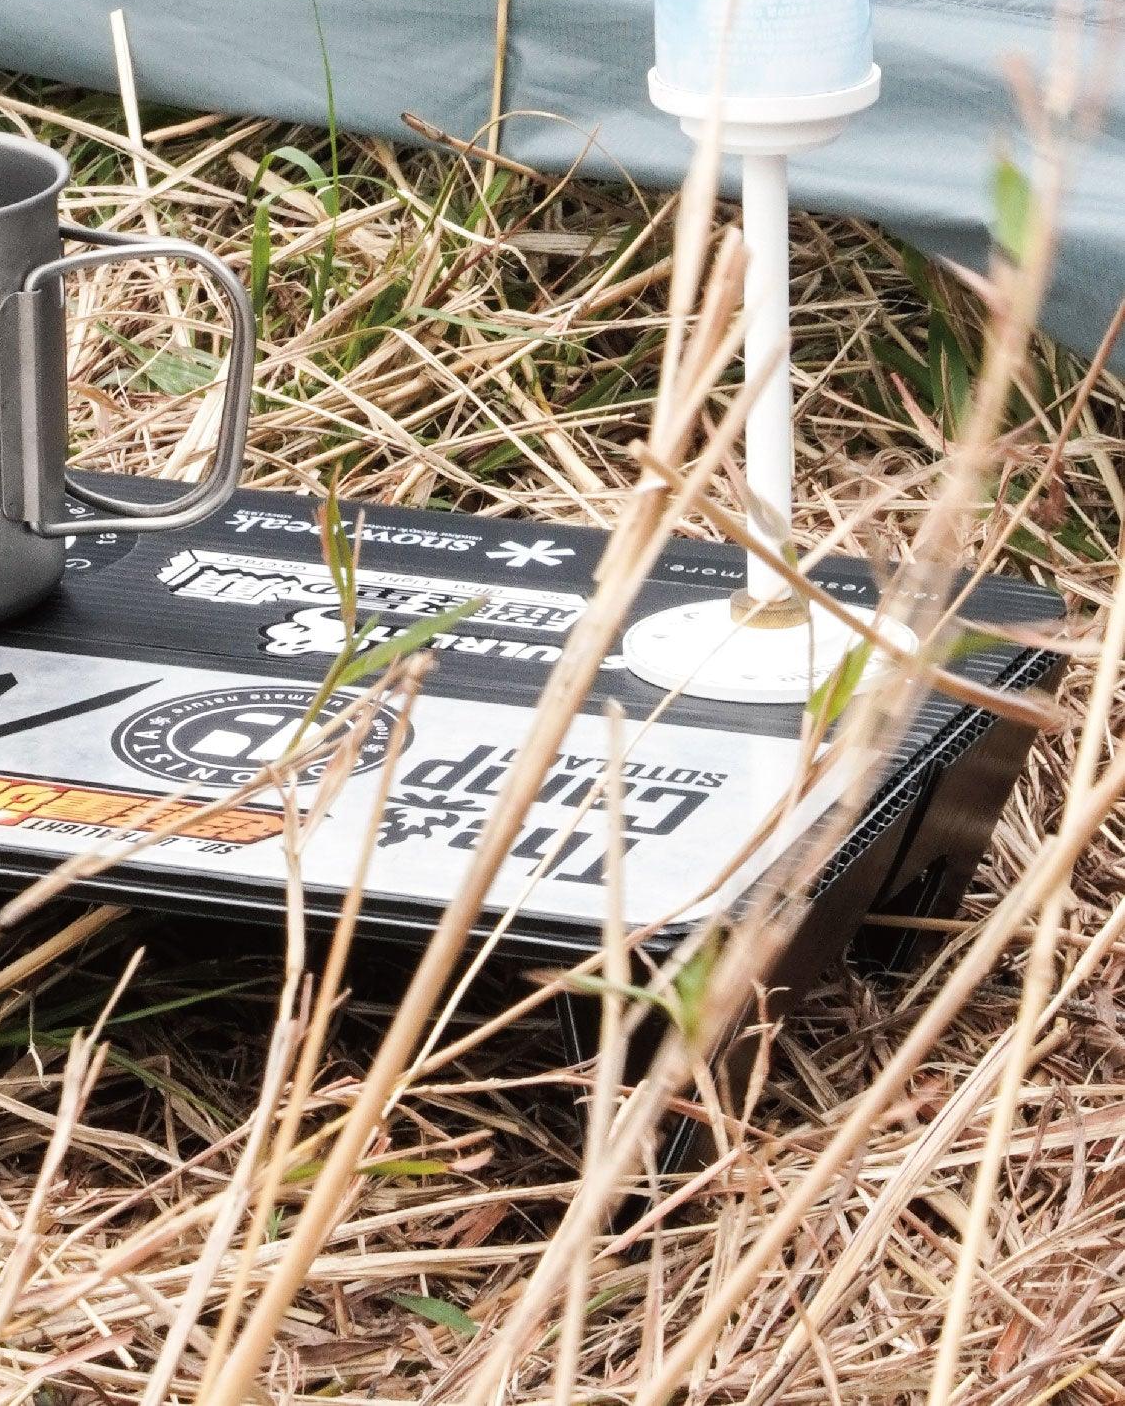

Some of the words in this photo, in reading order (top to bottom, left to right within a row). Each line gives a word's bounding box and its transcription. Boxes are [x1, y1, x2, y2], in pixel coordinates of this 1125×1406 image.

[346, 530, 476, 551] snow
[504, 748, 728, 789] SOTOLAO
[401, 744, 710, 836] Camp
[22, 821, 180, 847] UTALIGHT
